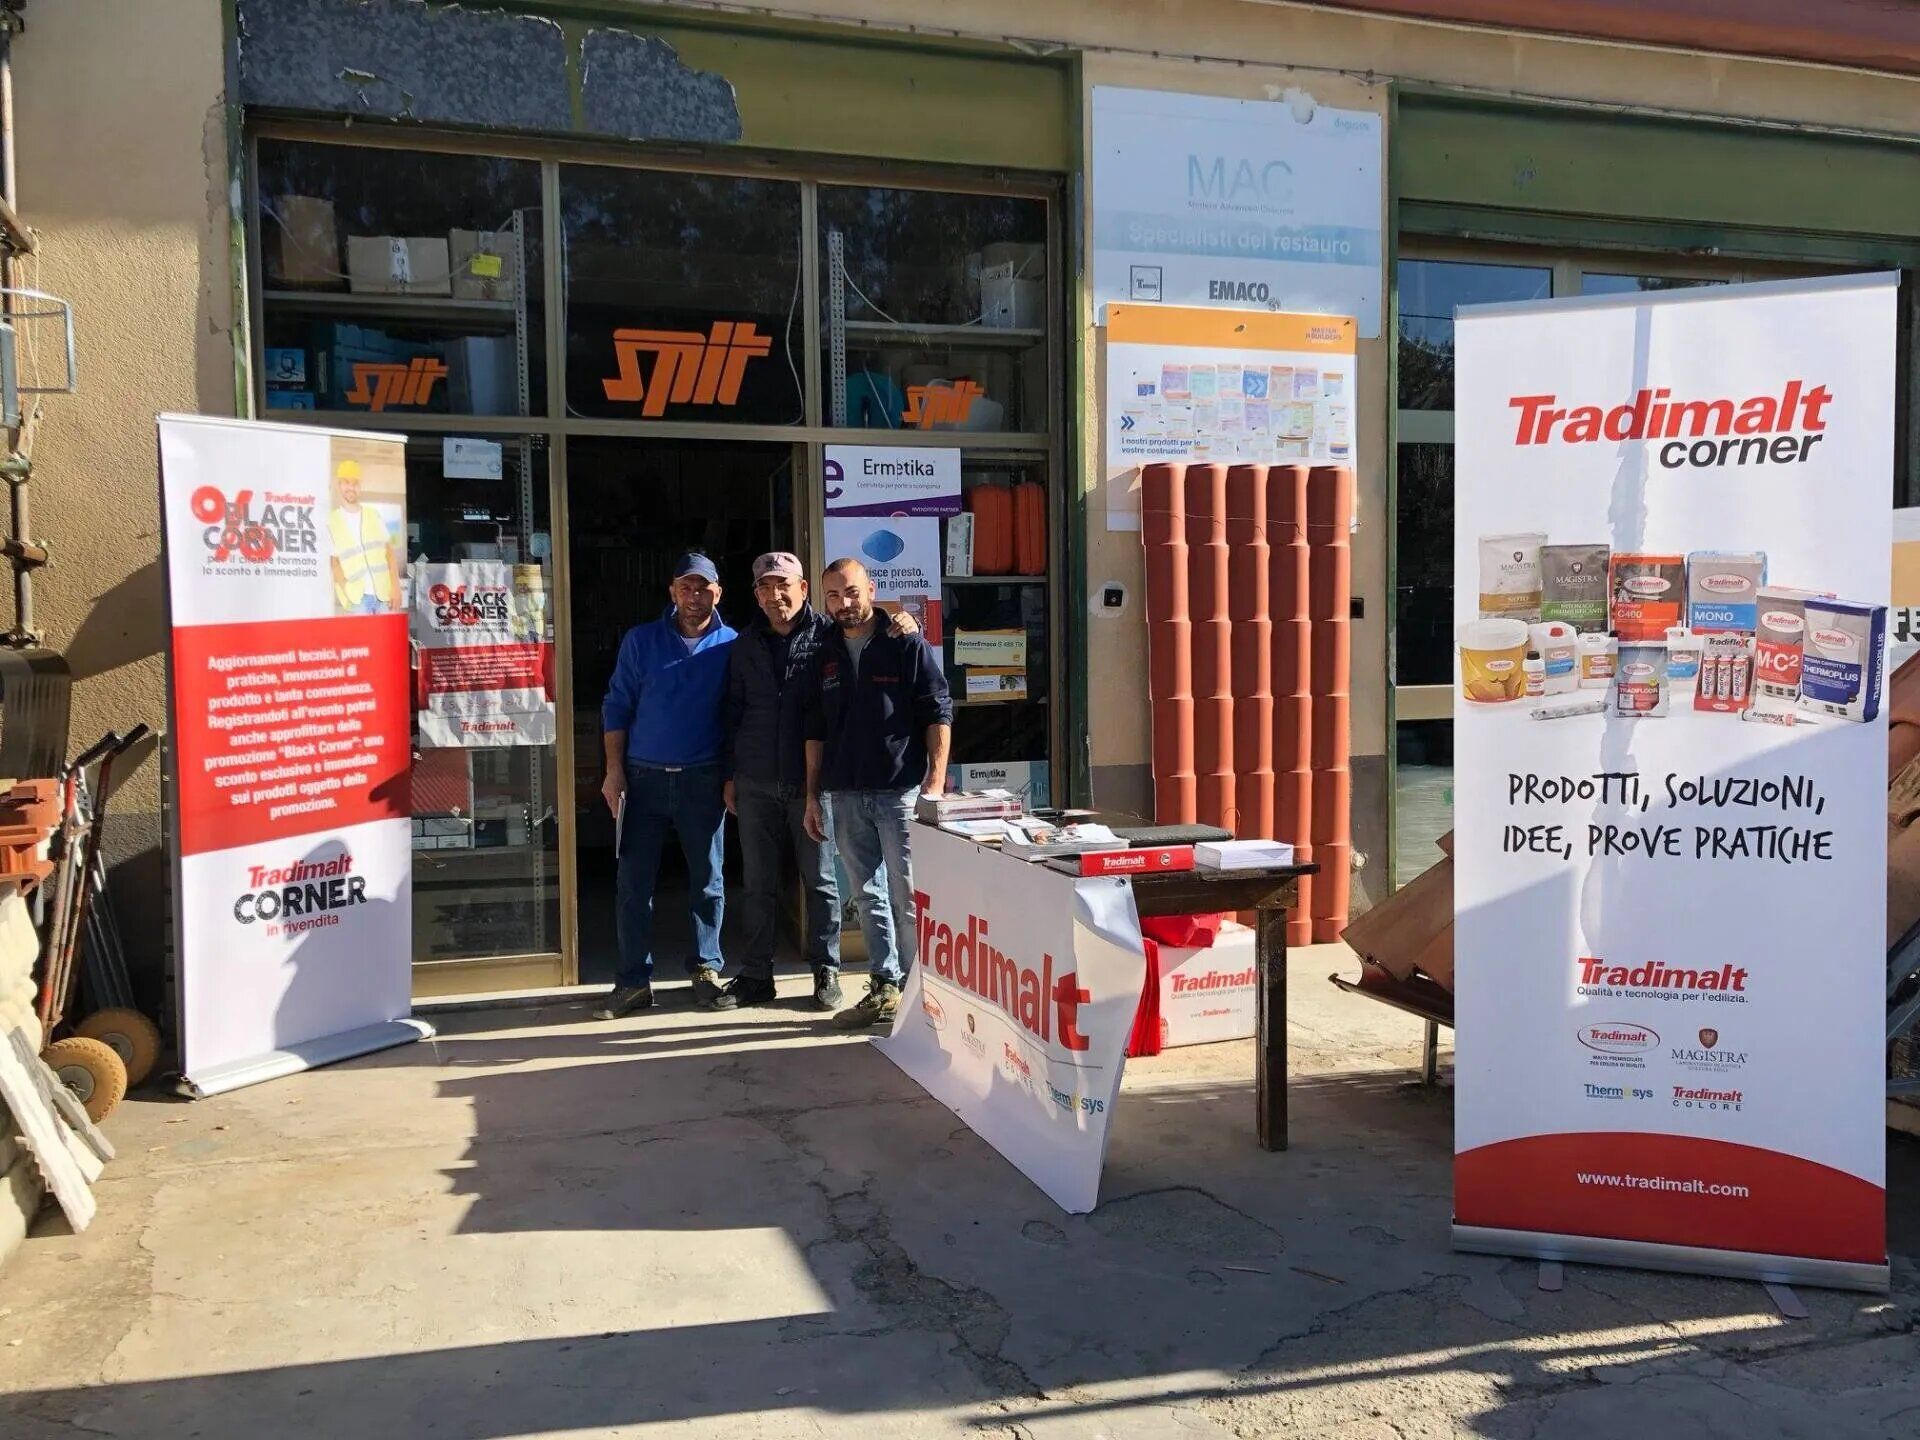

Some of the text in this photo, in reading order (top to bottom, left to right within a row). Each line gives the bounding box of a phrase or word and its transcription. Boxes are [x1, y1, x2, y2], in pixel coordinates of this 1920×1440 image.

[1187, 154, 1293, 201] MAC
[1128, 223, 1350, 255] Specialisti del restauro
[1209, 280, 1269, 302] EMACO
[1508, 380, 1833, 446] Tradimalt
[1126, 437, 1148, 445] nostri
[1149, 439, 1179, 447] prodotti
[1180, 440, 1193, 448] per
[1146, 447, 1187, 455] costruzioni
[1659, 434, 1823, 470] corner
[264, 492, 315, 504] Tradimalt
[225, 502, 316, 529] BLACK
[203, 526, 318, 553] CORNER
[215, 566, 251, 576] sconto
[264, 566, 318, 578] immediato
[277, 555, 317, 566] formato
[1501, 562, 1536, 571] MAGISTRA
[878, 579, 932, 591] in giornata.
[891, 568, 924, 578] presto.
[1555, 575, 1599, 584] MAGISTRA
[449, 592, 507, 606] BLACK
[435, 605, 509, 620] CORNER
[1694, 611, 1734, 622] MONO
[207, 647, 370, 671] Aggiornamenti tecnici, prove
[227, 664, 357, 690] pratiche, innovazioni di
[1803, 664, 1858, 682] THERMOPLUS
[208, 683, 374, 711] prodotto e tanta convenienza.
[207, 699, 377, 730] Registrandoti all'evento potrai
[461, 720, 516, 732] Tradimalt
[229, 720, 362, 746] anche approfittare della
[204, 750, 276, 772] promozione
[364, 735, 384, 748] uno
[215, 754, 378, 788] sconto esclusivo e immediato
[231, 772, 368, 806] sui prodotti oggetto della
[1509, 773, 1825, 815] PRODOTTI, SOLUZIONI,
[270, 797, 338, 821] promozione.
[1503, 824, 1833, 865] IDEE, PROVE PRATICHE
[247, 853, 353, 889] Tradimalt
[1103, 855, 1146, 867] Tradimalt
[233, 875, 367, 925] CORNER
[266, 913, 339, 937] in rivendita
[914, 889, 1090, 1052] Tradimalt
[1578, 957, 1748, 992] Tradimalt
[1577, 986, 1613, 998] Qualità
[1625, 989, 1679, 1001] tecnologia
[1682, 993, 1699, 1003] per
[1702, 992, 1749, 1004] l'edilizia.
[1590, 1029, 1647, 1042] Tradimalt
[1671, 1049, 1746, 1064] MAGISTRA
[1672, 1086, 1743, 1102] Tradimalt
[1577, 1171, 1749, 1198] www.tradimalt.com
